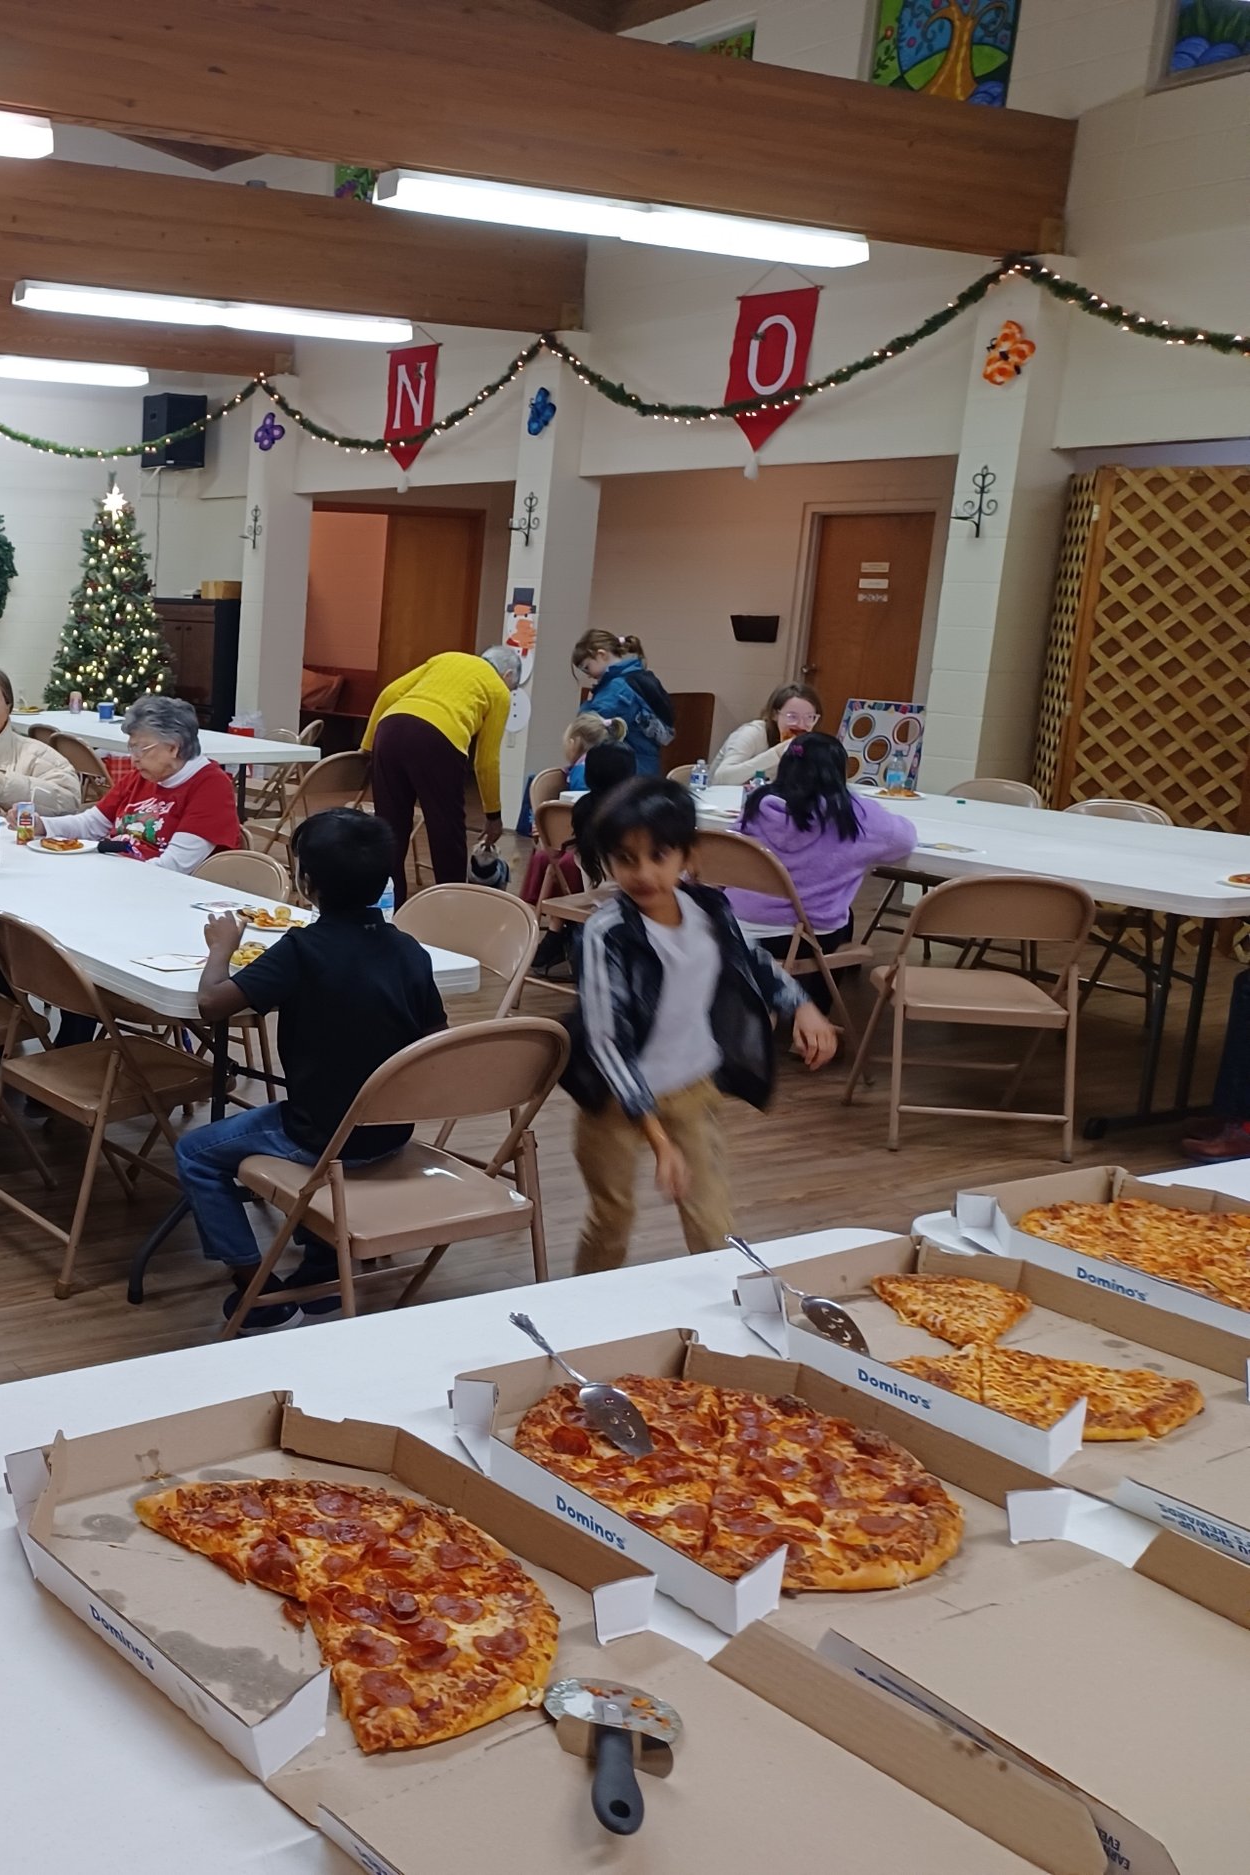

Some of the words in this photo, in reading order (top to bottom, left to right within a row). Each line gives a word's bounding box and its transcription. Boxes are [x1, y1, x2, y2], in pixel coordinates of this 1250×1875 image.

[392, 362, 428, 429] N
[1076, 1266, 1147, 1301] Domino's
[858, 1368, 931, 1410] Domino's
[556, 1494, 626, 1550] Domino's
[89, 1604, 155, 1671] Domino's
